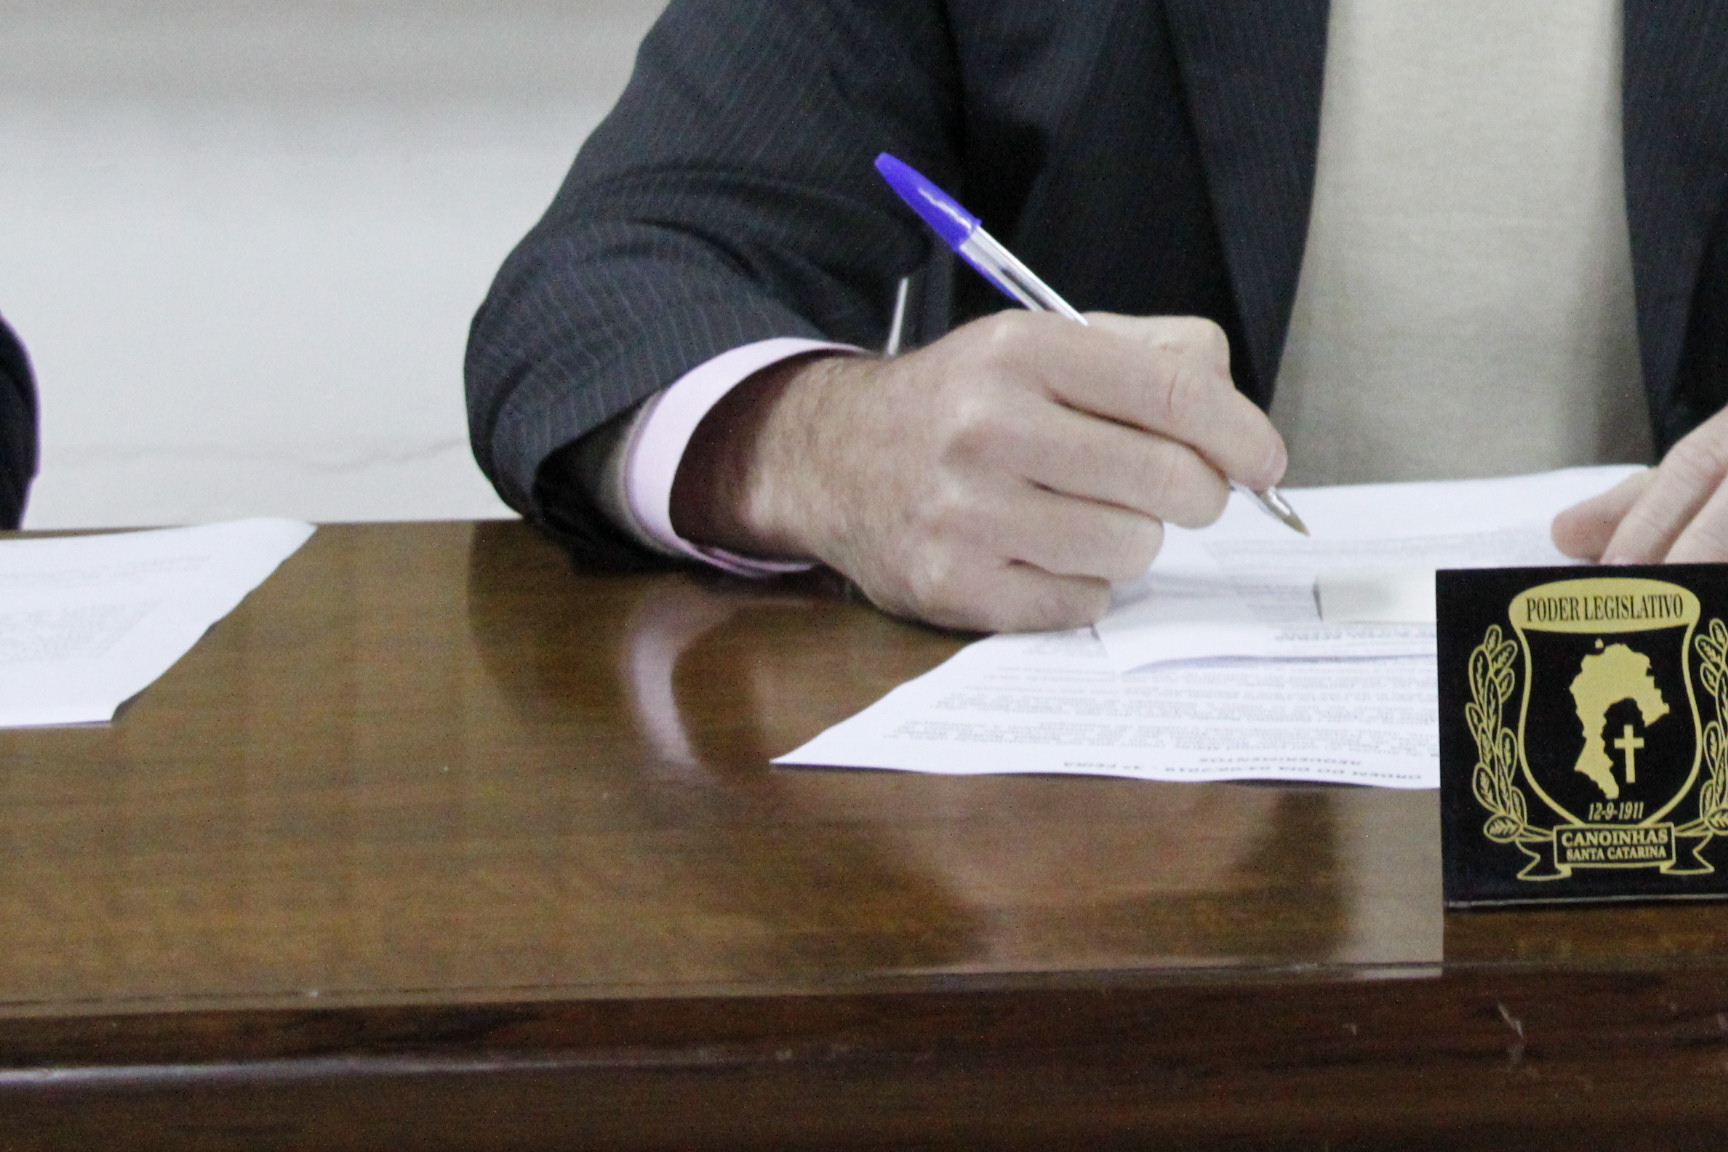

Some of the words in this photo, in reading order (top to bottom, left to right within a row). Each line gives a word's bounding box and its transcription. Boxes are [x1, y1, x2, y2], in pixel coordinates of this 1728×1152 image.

[1526, 597, 1580, 622] PODER
[1584, 593, 1684, 620] LEGISLATIVO
[1588, 801, 1644, 821] 12-9-1911
[1561, 828, 1669, 847] CANOINHAS
[1566, 848, 1605, 861] SANTA
[1607, 846, 1667, 860] CATARINA
